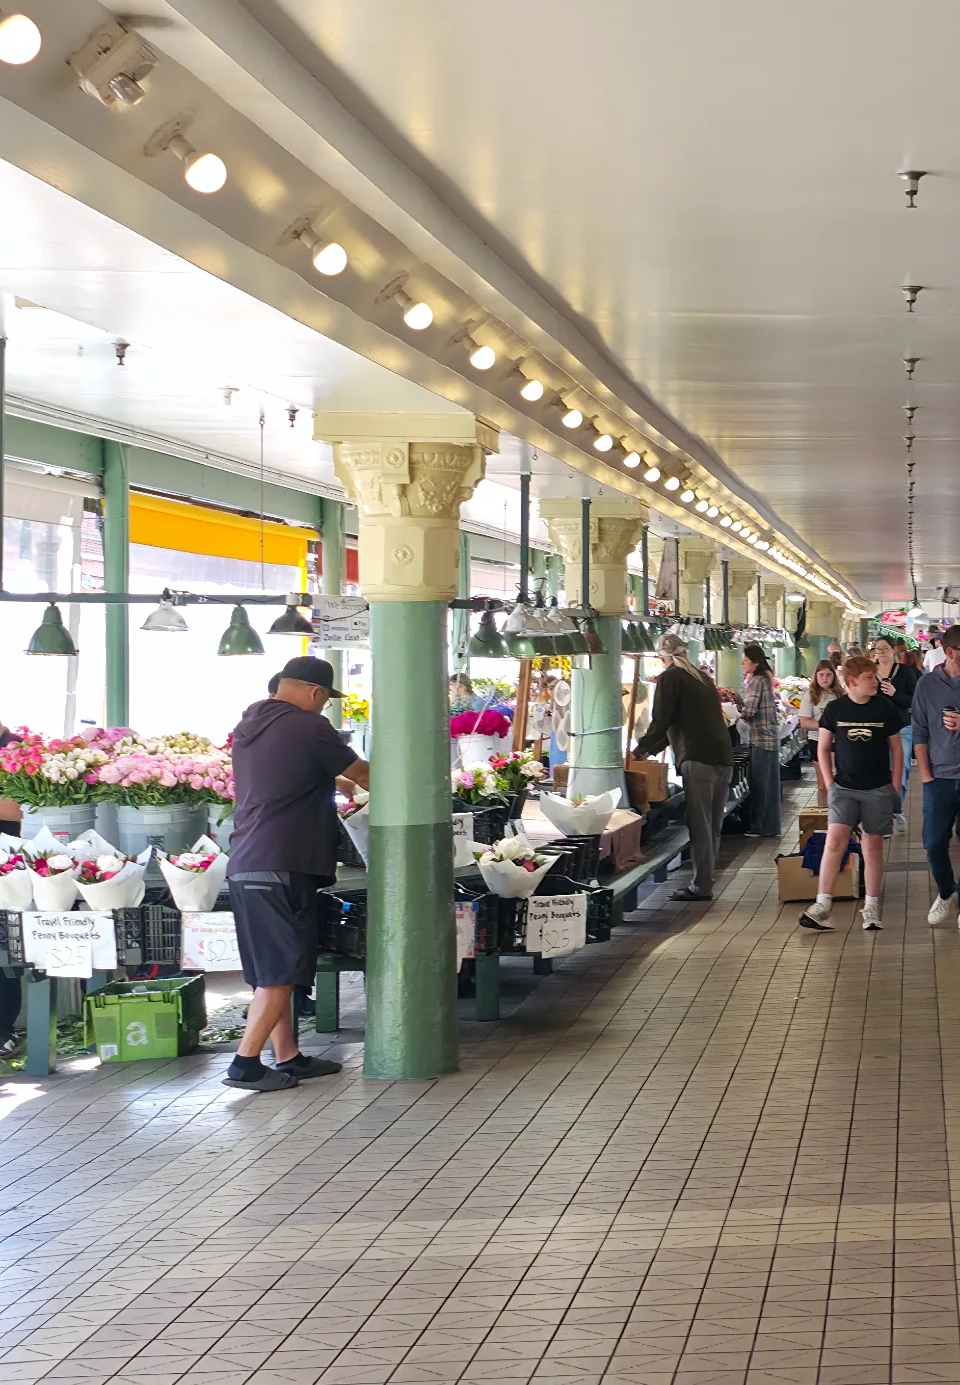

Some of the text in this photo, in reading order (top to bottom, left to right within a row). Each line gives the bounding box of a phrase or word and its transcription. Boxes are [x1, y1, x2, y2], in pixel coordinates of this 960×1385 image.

[34, 915, 96, 931] Travel Friendly
[48, 945, 87, 970] $25
